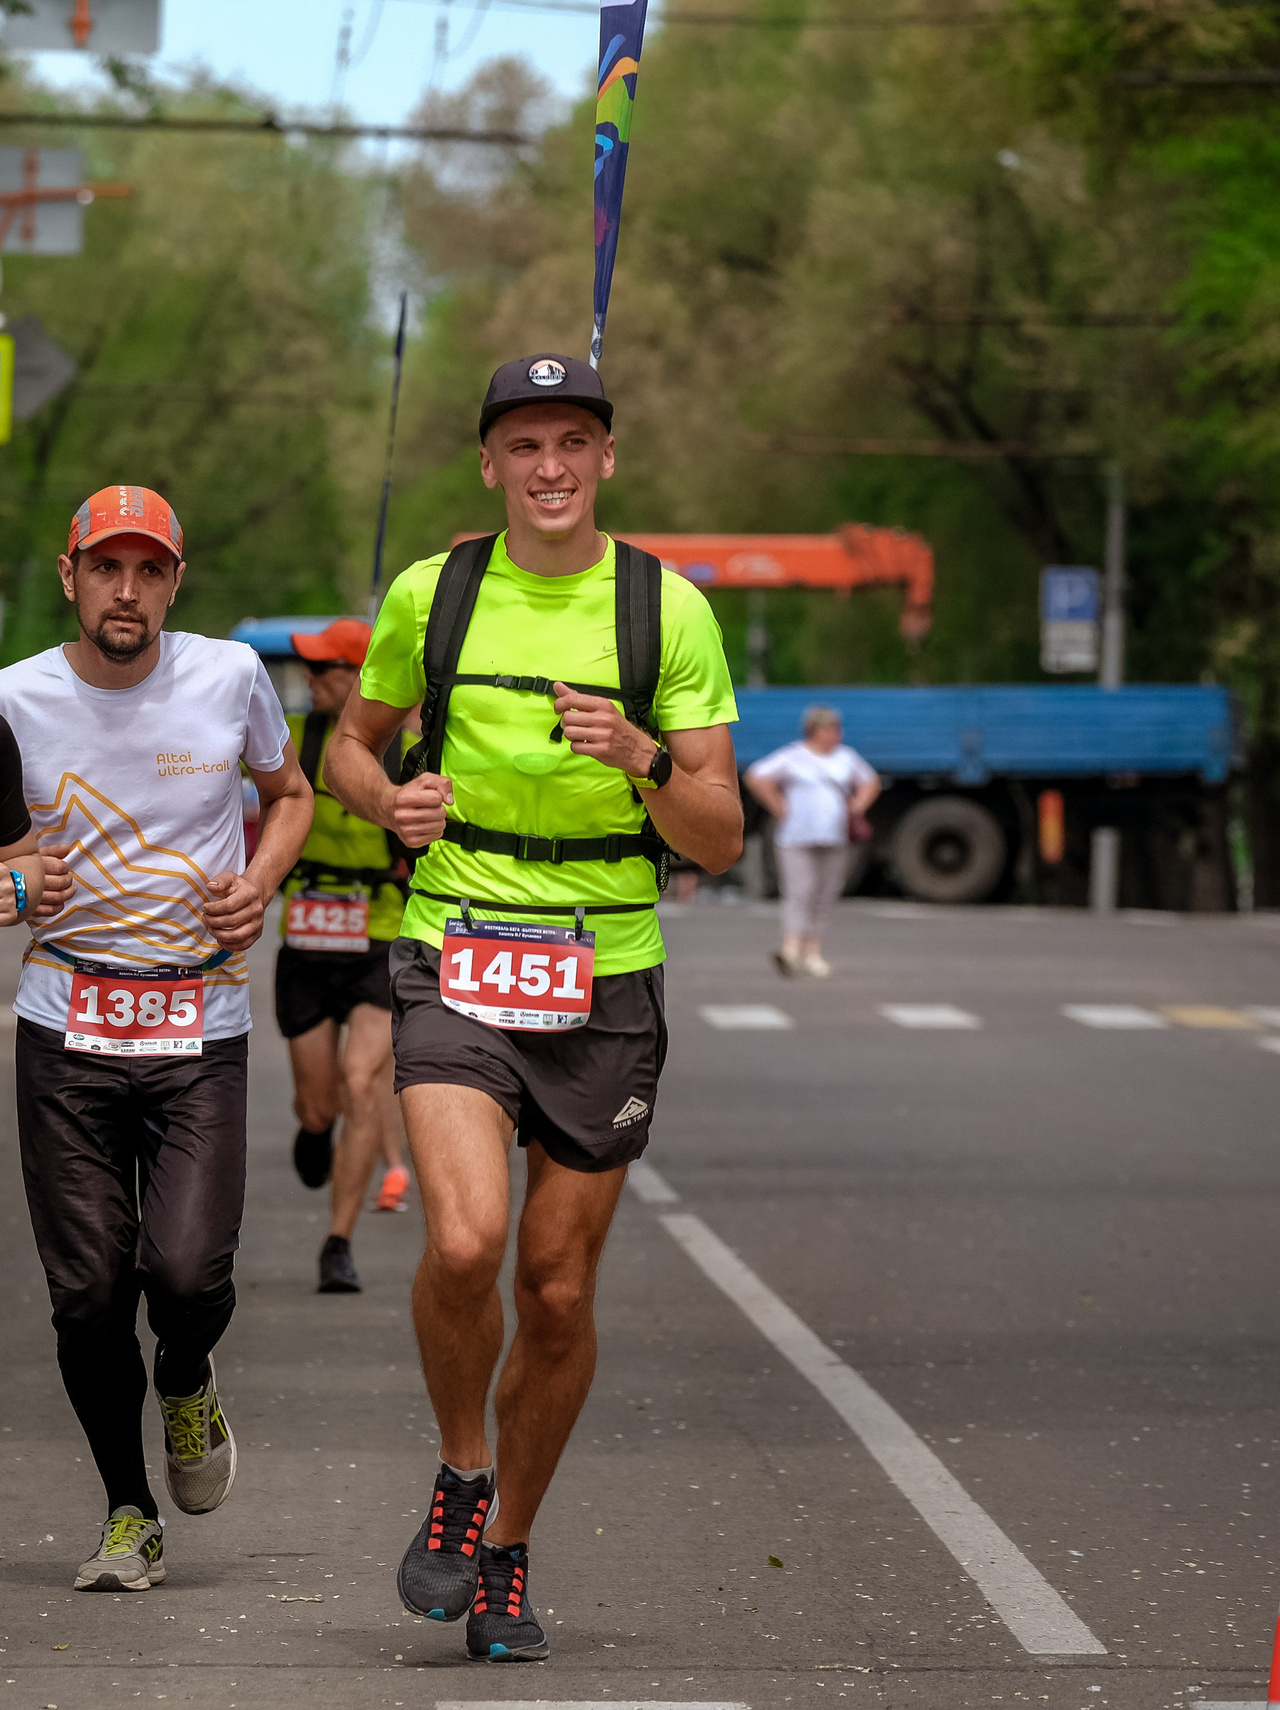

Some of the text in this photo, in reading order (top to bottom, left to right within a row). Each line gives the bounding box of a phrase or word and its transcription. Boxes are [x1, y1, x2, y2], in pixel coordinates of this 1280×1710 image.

[156, 751, 192, 764] Altai
[158, 760, 230, 777] ultra-trail
[291, 904, 365, 933] 1425
[448, 948, 585, 1000] 1451
[76, 985, 198, 1027] 1385
[613, 1119, 632, 1130] NIKE
